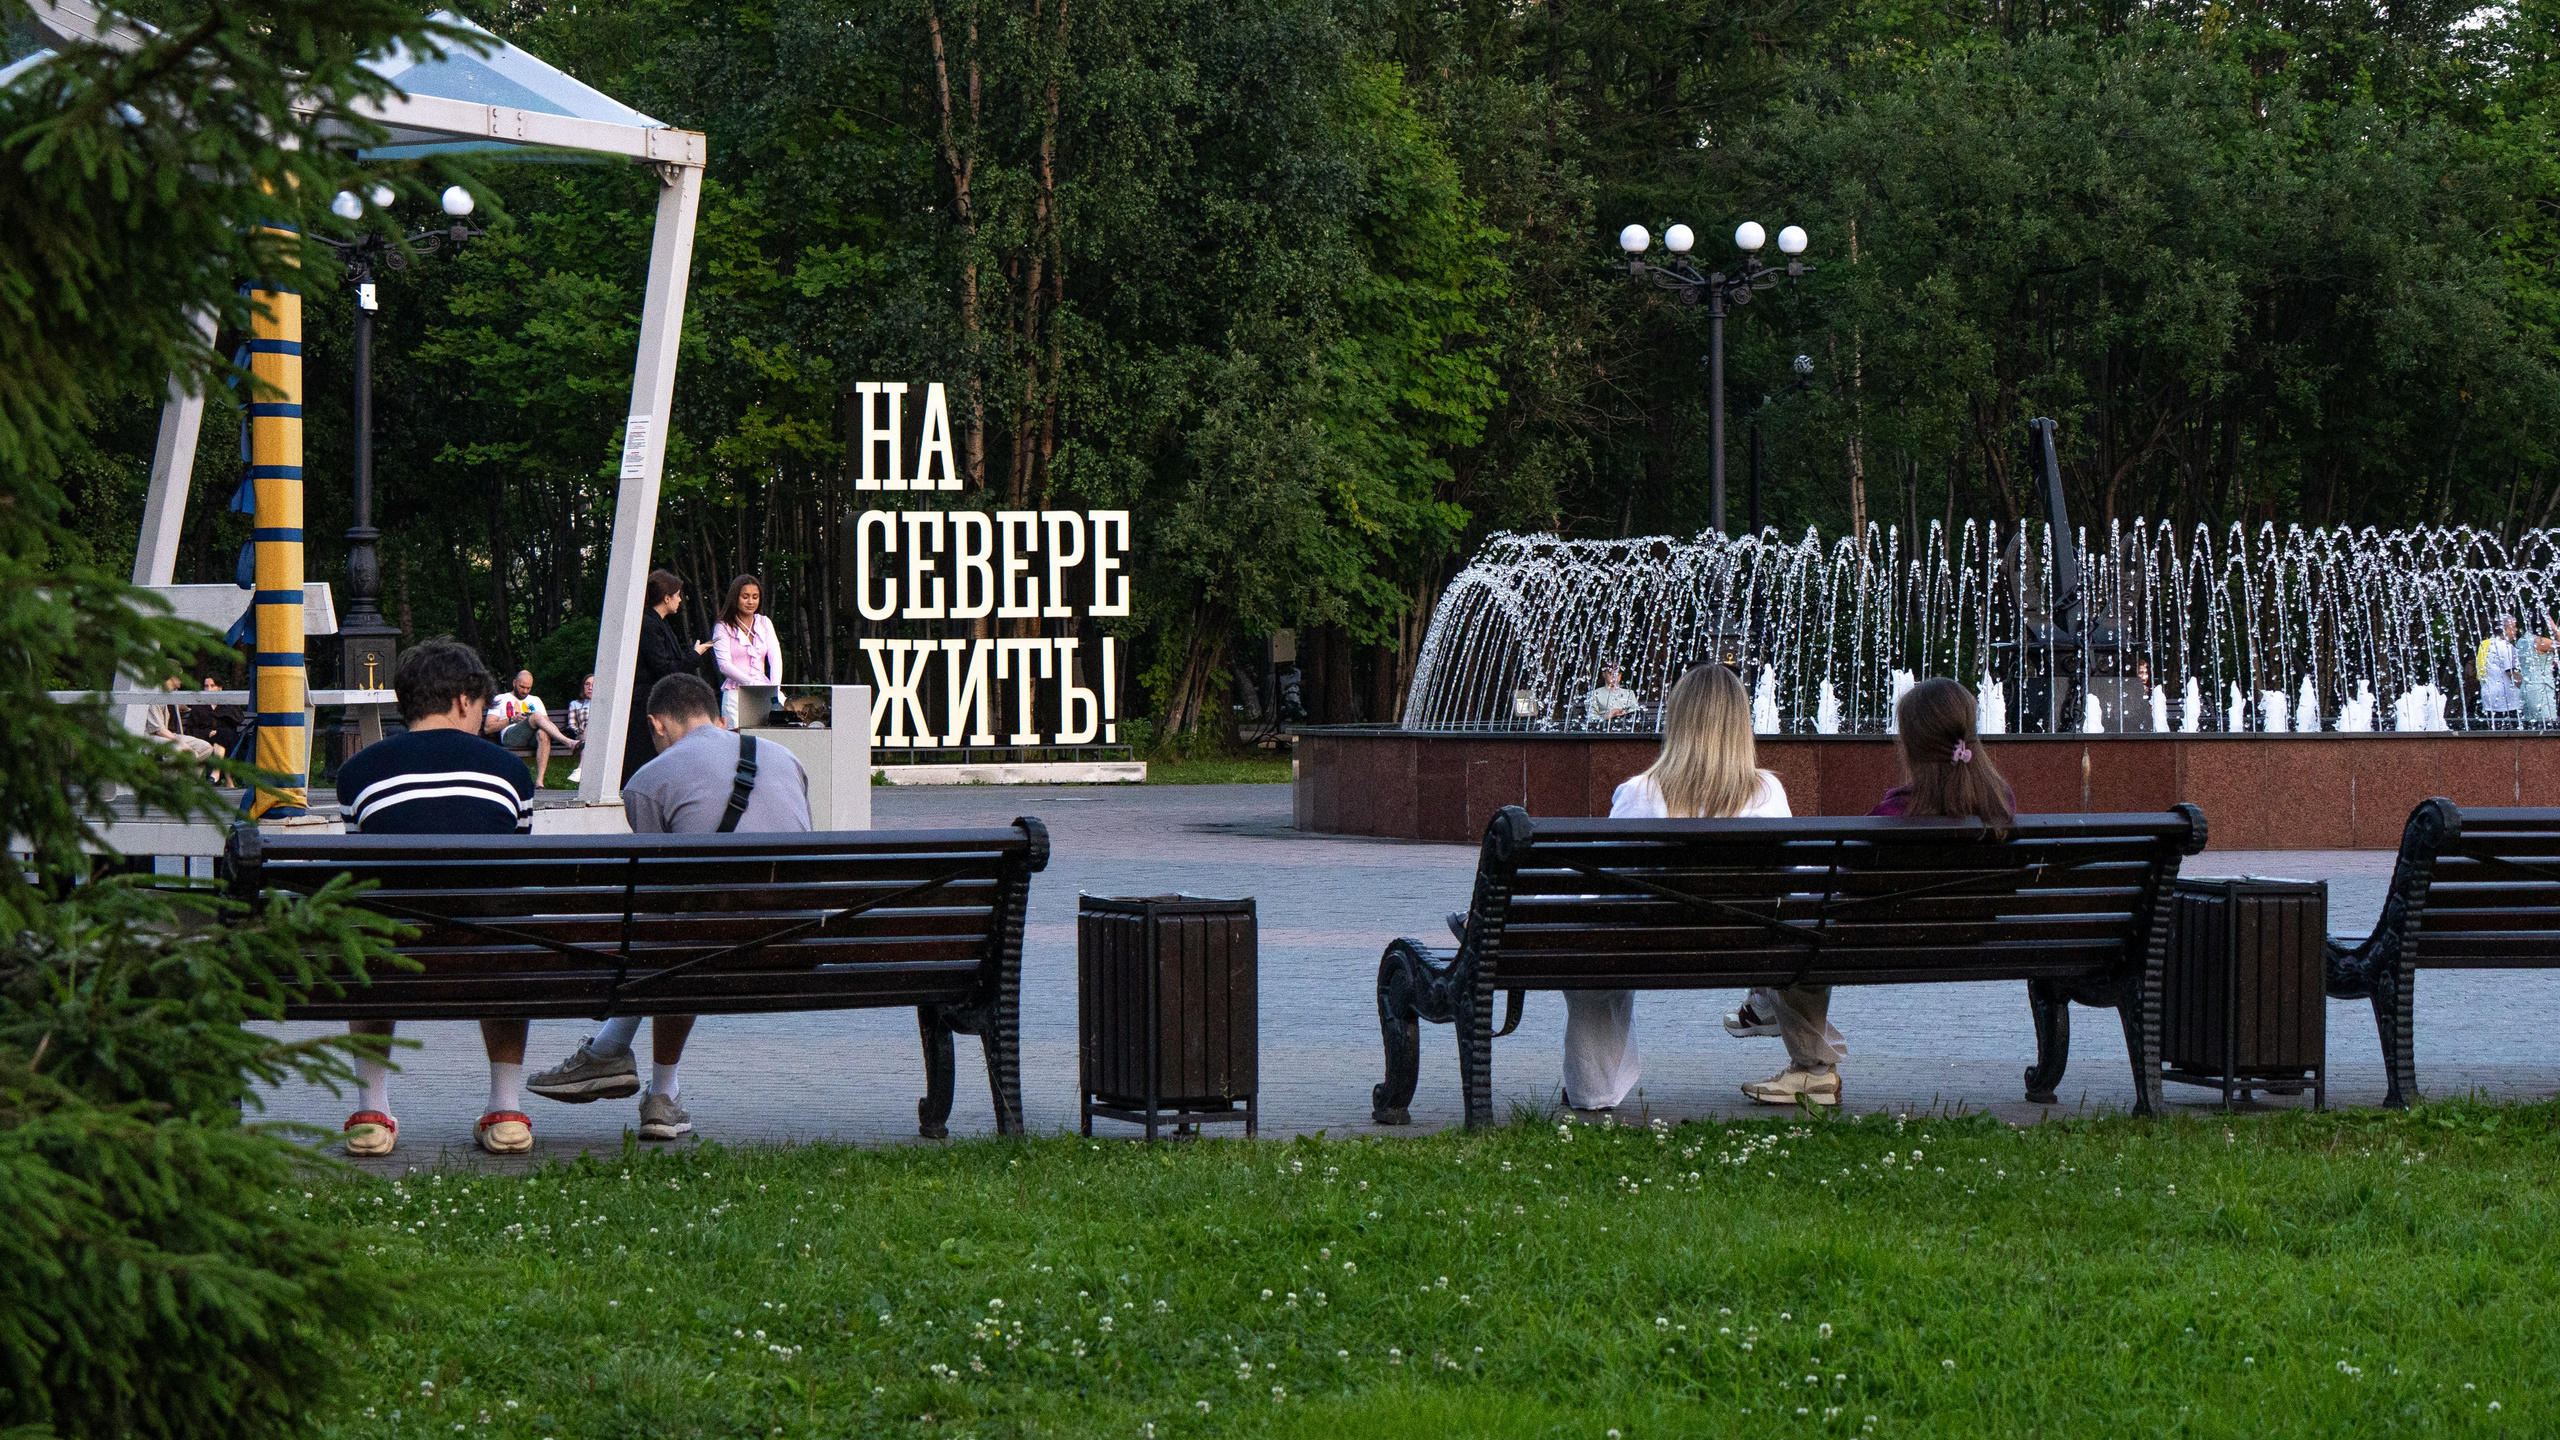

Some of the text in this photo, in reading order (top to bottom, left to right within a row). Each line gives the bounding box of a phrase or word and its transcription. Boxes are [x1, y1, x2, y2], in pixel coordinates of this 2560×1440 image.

[855, 381, 963, 491] НА
[856, 509, 1130, 621] СЕВЕРЕ
[859, 636, 1117, 748] ЖИТЬ!
